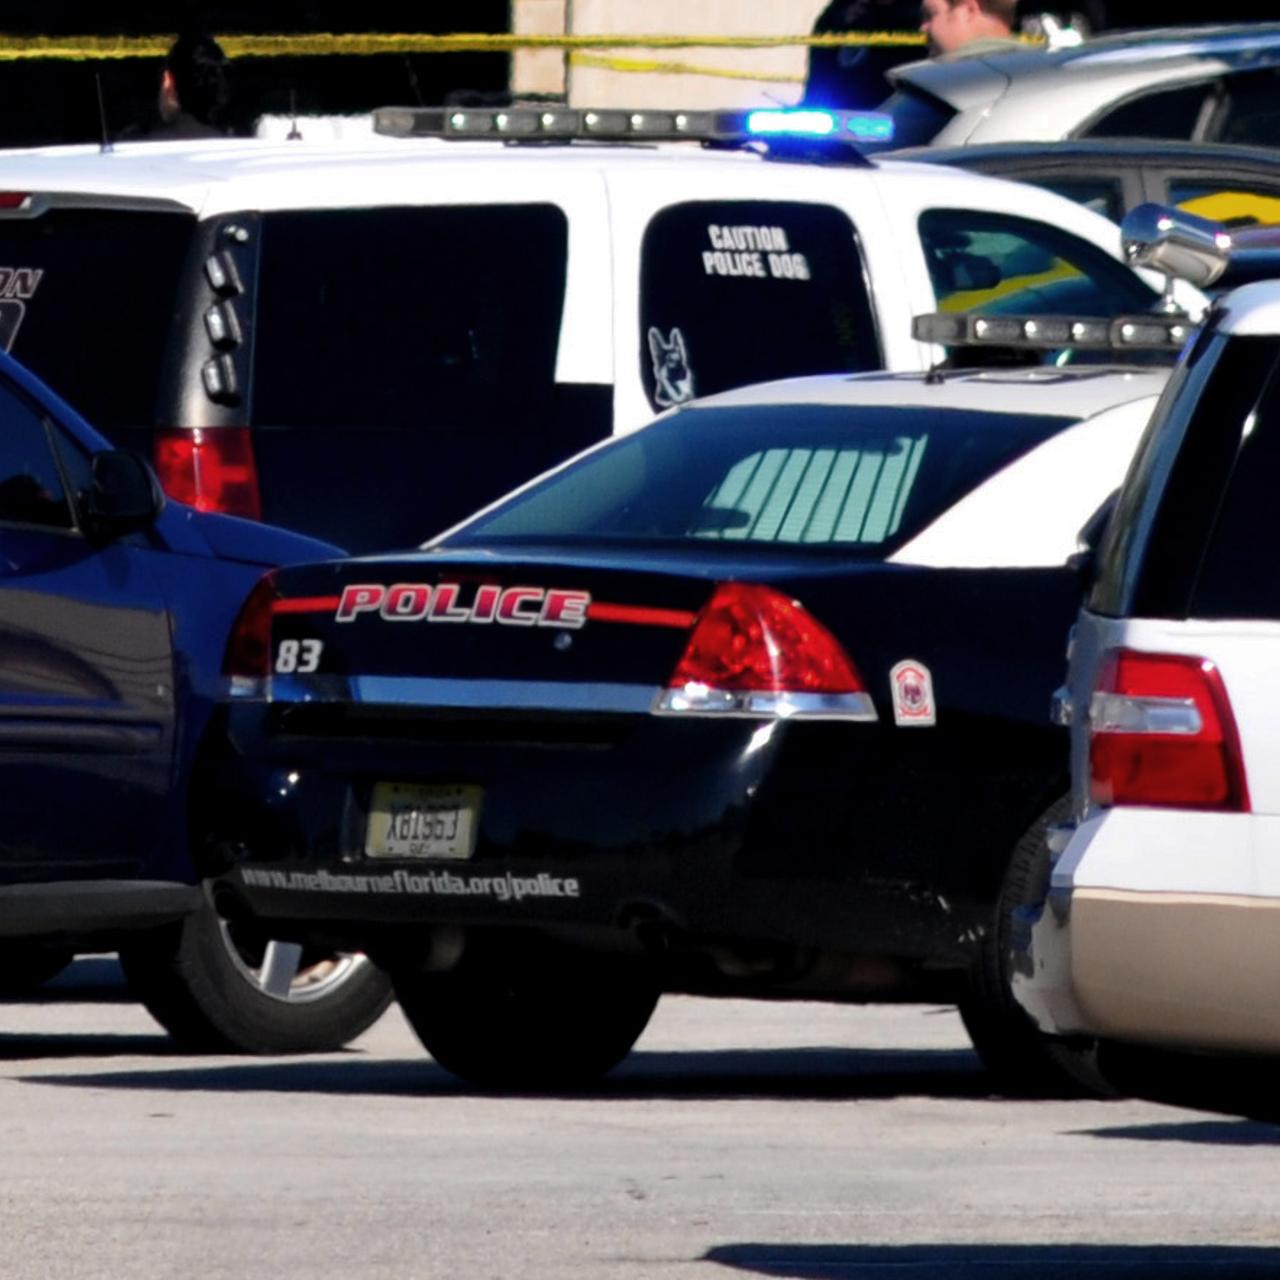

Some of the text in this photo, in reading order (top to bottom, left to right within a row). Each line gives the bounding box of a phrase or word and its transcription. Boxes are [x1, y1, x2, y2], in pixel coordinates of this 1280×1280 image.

[706, 224, 789, 252] CAUTION
[702, 251, 811, 280] POLICE DOG
[335, 583, 591, 630] POLICE
[274, 638, 323, 674] 83
